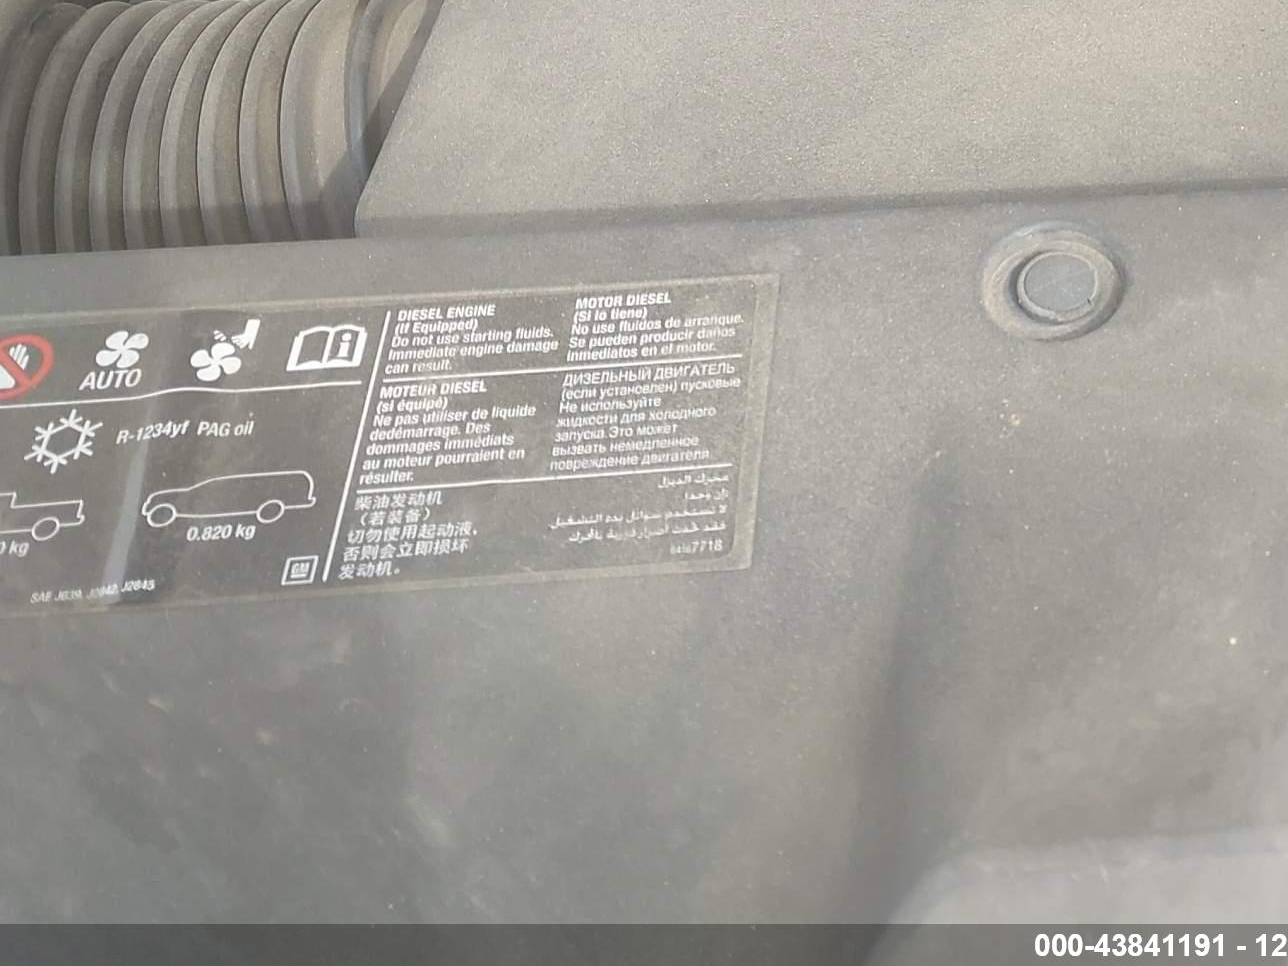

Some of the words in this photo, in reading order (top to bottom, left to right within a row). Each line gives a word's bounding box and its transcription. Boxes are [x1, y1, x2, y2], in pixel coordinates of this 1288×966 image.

[575, 294, 623, 309] MOTOR
[626, 291, 671, 306] DIESEL
[398, 307, 443, 321] DIESEL
[446, 304, 496, 319] ENGINE
[594, 308, 607, 322] lo
[610, 306, 648, 321] tiene)
[394, 322, 410, 336] (If
[412, 318, 479, 334] Equipped)
[571, 324, 589, 335] No
[591, 322, 615, 334] use
[619, 318, 662, 333] fluidos
[664, 316, 681, 328] de
[684, 313, 744, 329] arranque.
[391, 335, 408, 347] Do
[411, 334, 434, 347] not
[436, 333, 460, 345] use
[462, 328, 512, 344] starting
[515, 325, 554, 339] fluids.
[568, 337, 586, 349] Se
[588, 333, 637, 350] pueden
[639, 328, 692, 347] producir
[387, 344, 457, 361] Immediate
[460, 342, 504, 359] engine
[506, 336, 559, 353] damage
[641, 344, 658, 356] en
[660, 342, 673, 355] el
[676, 339, 717, 354] motor.
[384, 363, 409, 375] can
[412, 359, 452, 374] result.
[562, 367, 651, 388] ДИЗЕЛЬНЫЙ
[653, 361, 736, 382] ДВИГАТЕЛЬ
[79, 367, 143, 391] AUTO
[380, 384, 437, 400] MOTEUR
[440, 380, 487, 395] DIESEL
[376, 399, 394, 415] (si
[397, 396, 449, 414] équipé)
[559, 401, 578, 414] Не
[373, 414, 392, 427] Ne
[394, 413, 419, 429] pas
[422, 409, 468, 425] utiliser
[471, 407, 488, 421] de
[491, 403, 536, 421] liquide
[116, 418, 191, 446] R-1234yf
[196, 420, 232, 437] PAG
[234, 419, 256, 436] oil
[465, 421, 492, 435] Des
[366, 438, 441, 458] dommages
[362, 458, 380, 471] au
[383, 453, 433, 470] moteur
[434, 446, 505, 468] pourraient
[508, 448, 526, 461] en
[359, 469, 414, 487] résulter.
[354, 490, 444, 511] 柴油发动机
[186, 524, 232, 542] 0.820
[234, 522, 257, 541] kg
[9, 540, 30, 558] kg
[343, 538, 470, 562] 否则会立即损坏
